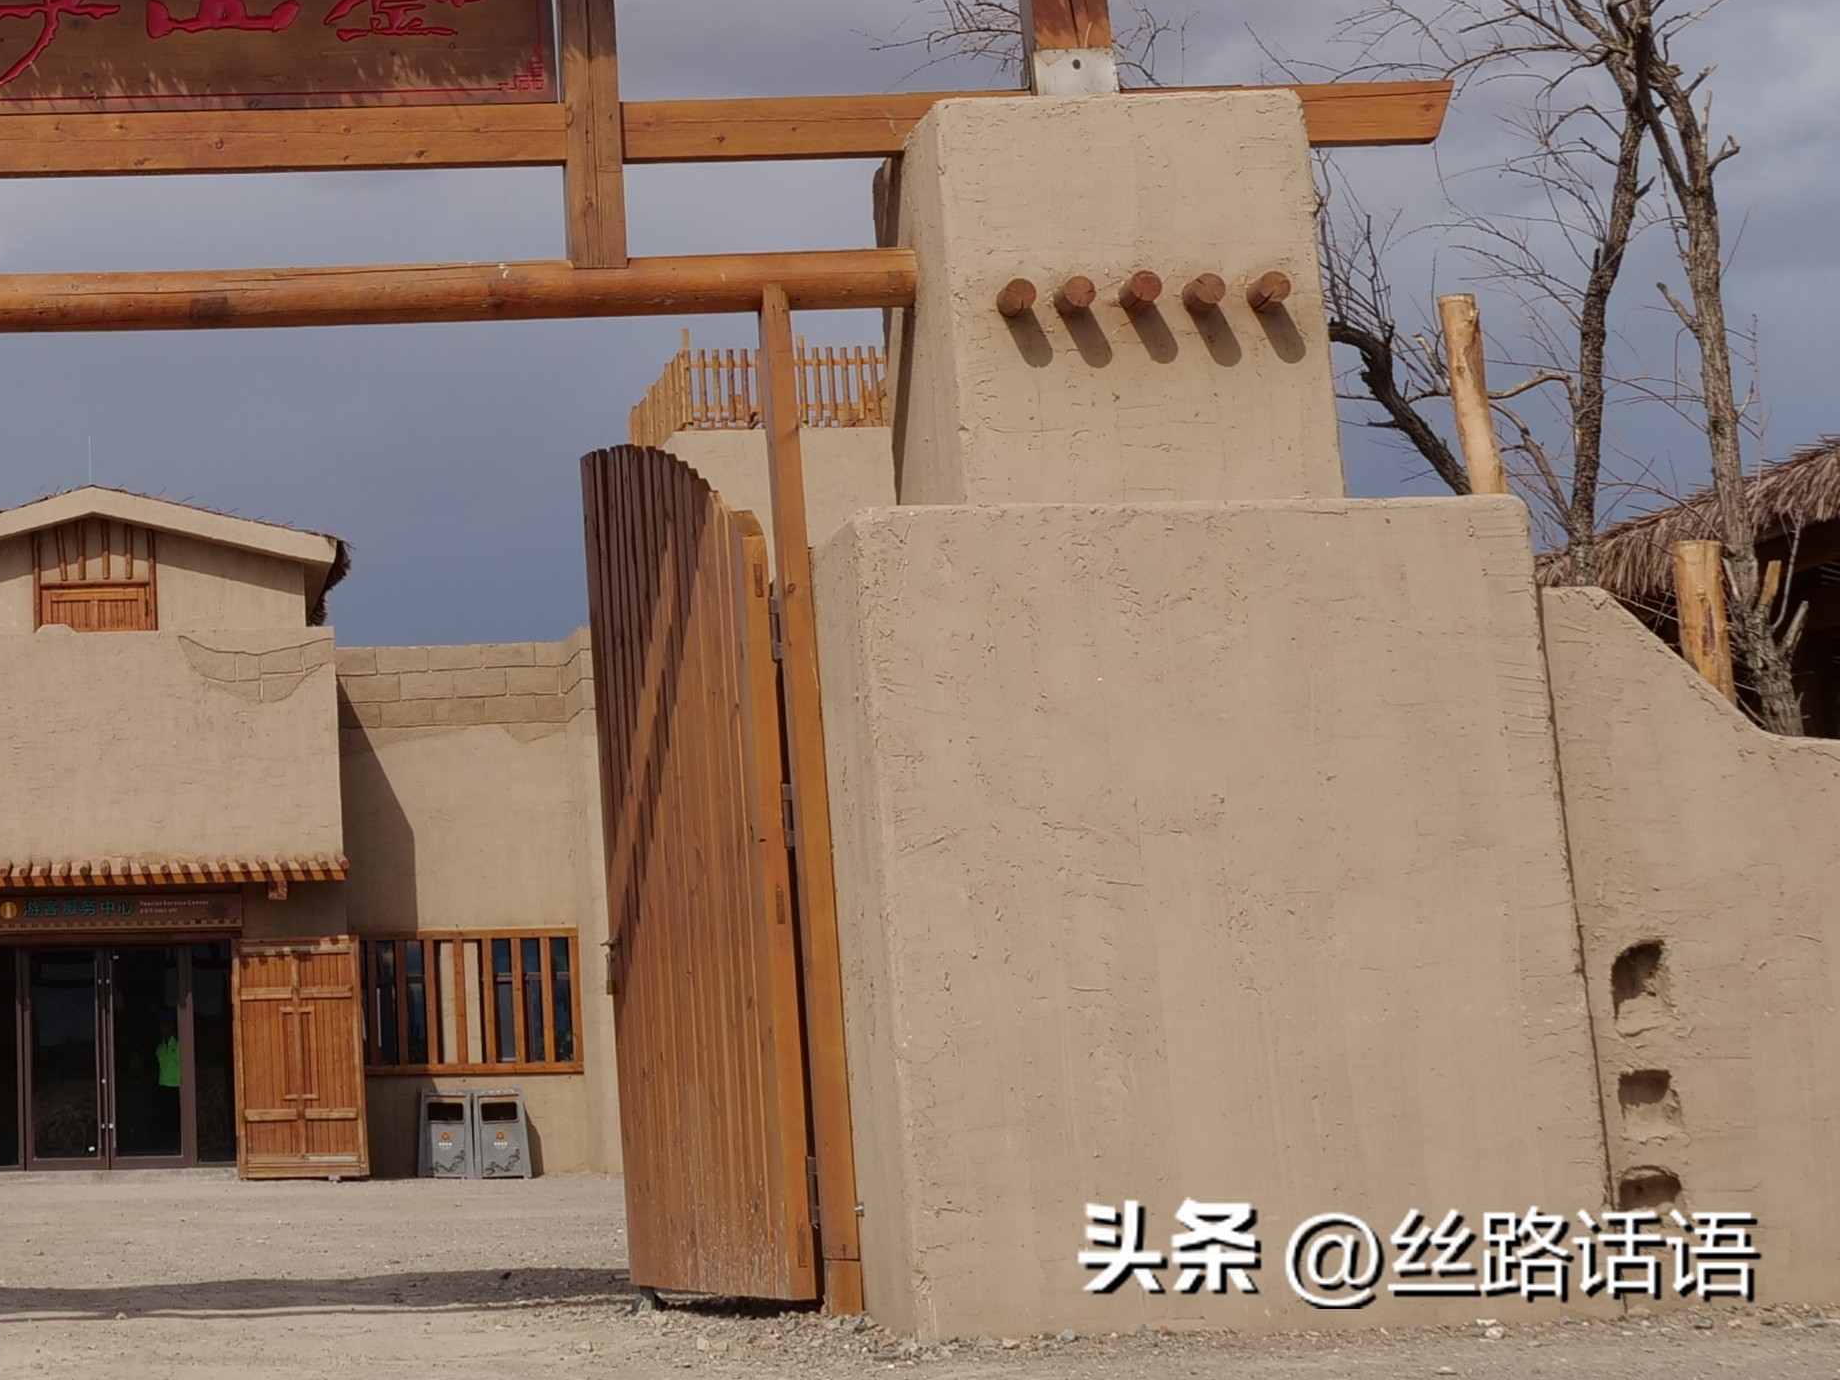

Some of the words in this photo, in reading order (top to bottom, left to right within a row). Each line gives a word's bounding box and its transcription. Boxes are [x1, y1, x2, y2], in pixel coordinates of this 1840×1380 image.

[22, 899, 133, 917] 游客服务中心
